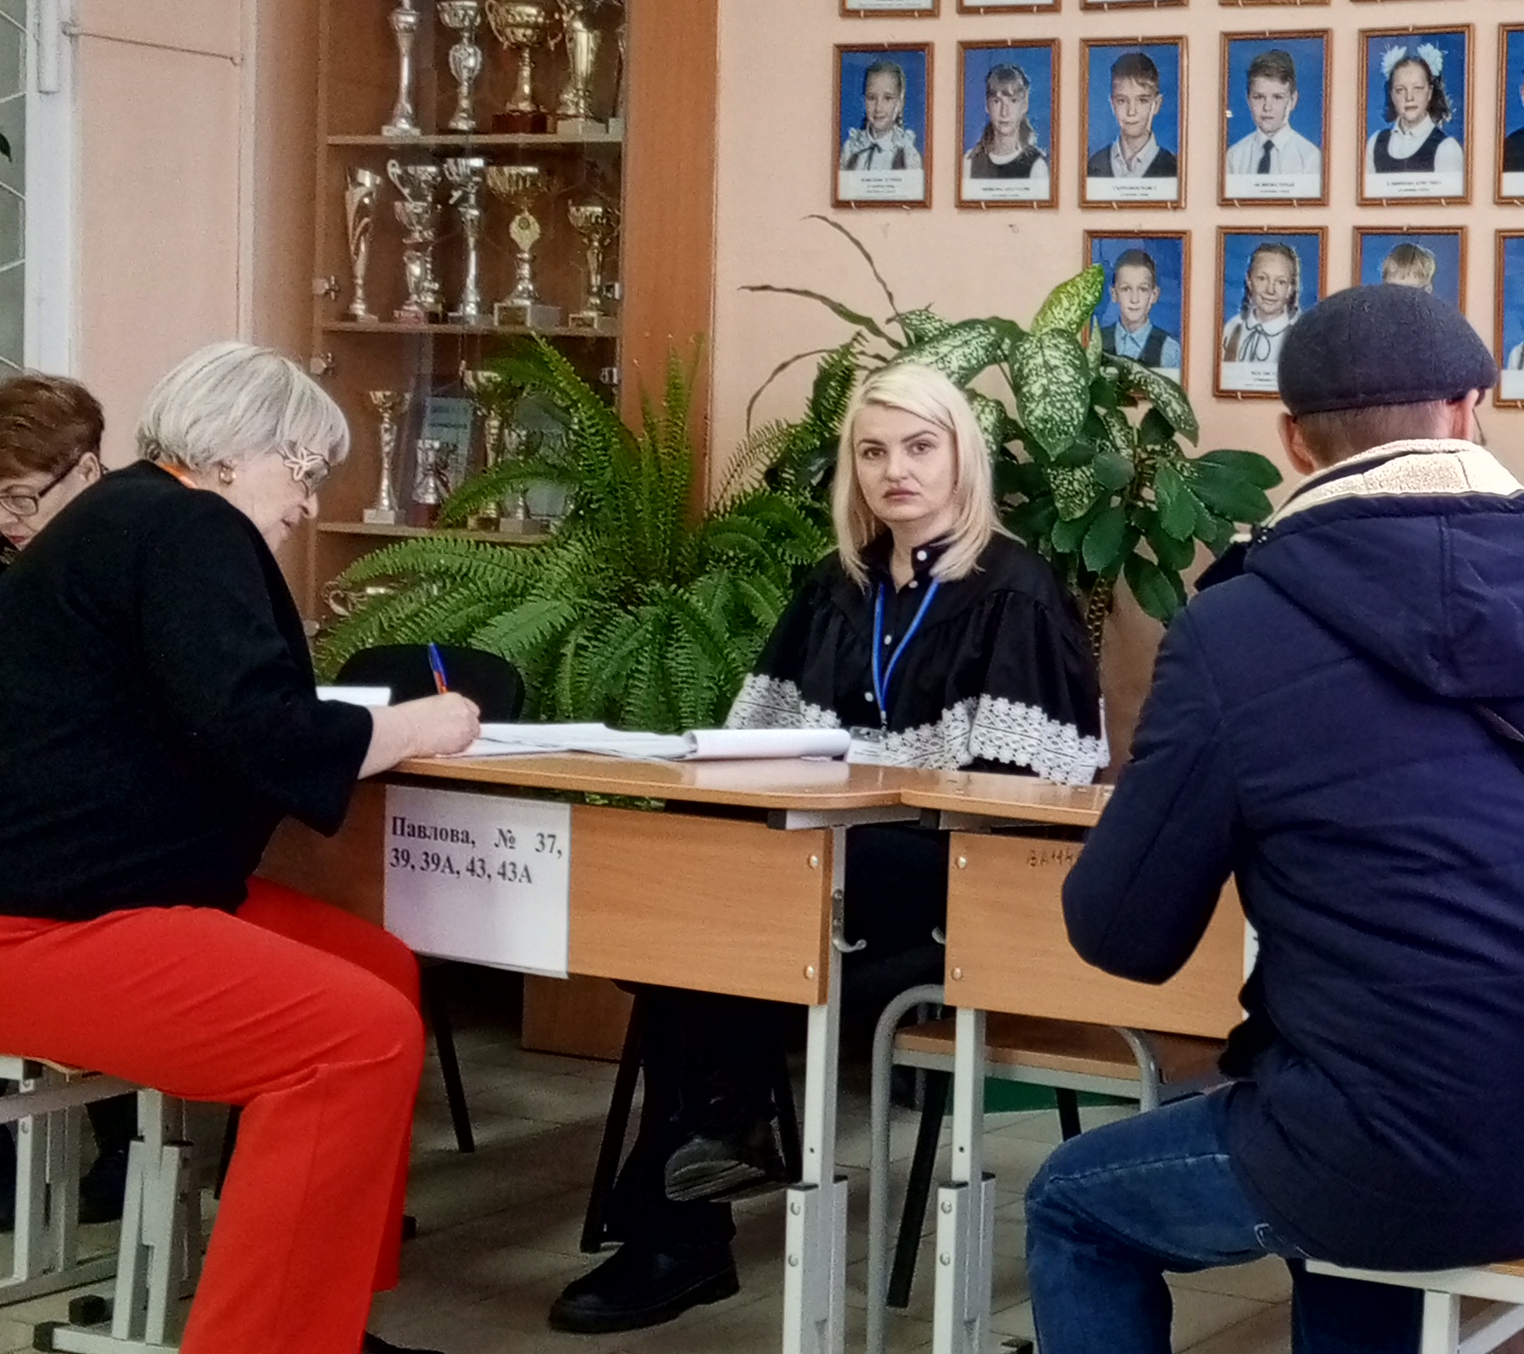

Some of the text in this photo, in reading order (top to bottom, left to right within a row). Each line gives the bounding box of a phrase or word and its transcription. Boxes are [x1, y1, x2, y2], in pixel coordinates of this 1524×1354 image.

[391, 816, 563, 859] Павлова, № 37,
[389, 847, 534, 884] 39, 39А, 43, 43А
